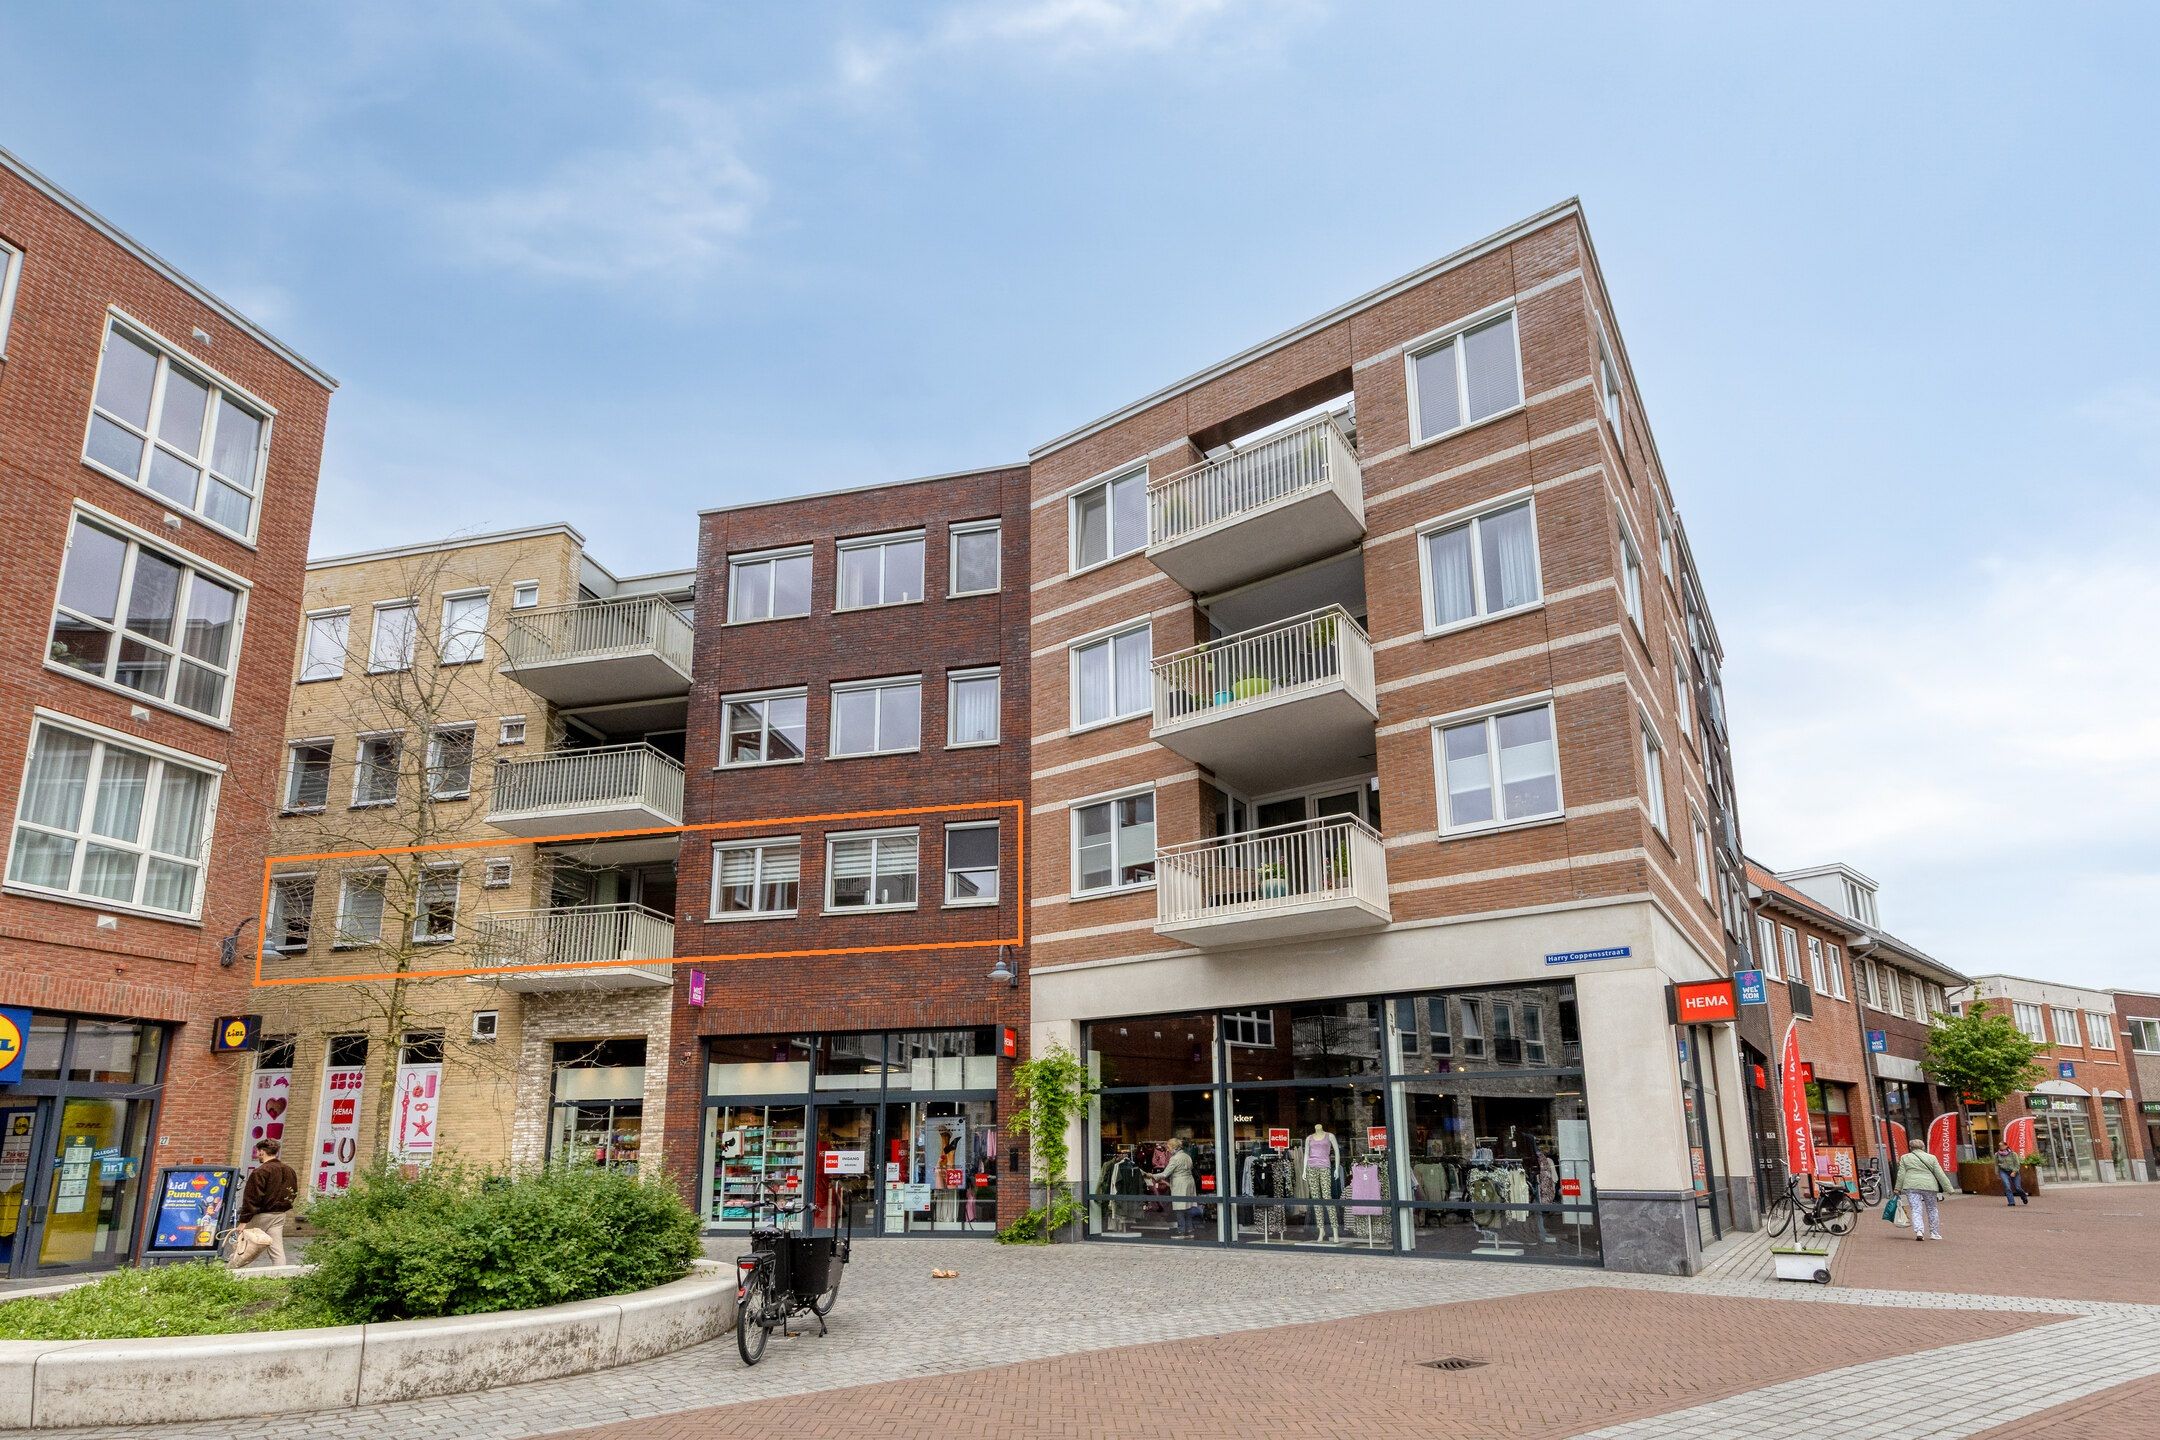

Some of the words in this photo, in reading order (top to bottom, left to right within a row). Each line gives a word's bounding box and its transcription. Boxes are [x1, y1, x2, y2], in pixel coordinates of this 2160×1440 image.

[1569, 949, 1624, 960] Coppensstraat
[1685, 995, 1728, 1009] HEMA
[332, 1108, 353, 1116] HEMA
[1270, 1134, 1288, 1142] actie
[1369, 1133, 1387, 1141] actie
[1942, 1116, 1950, 1152] ROSMALEN
[160, 1136, 168, 1145] 27
[1795, 1126, 1808, 1172] HEMA
[102, 1162, 123, 1172] nr.1
[168, 1181, 188, 1190] Lidl
[166, 1190, 203, 1198] Punten.
